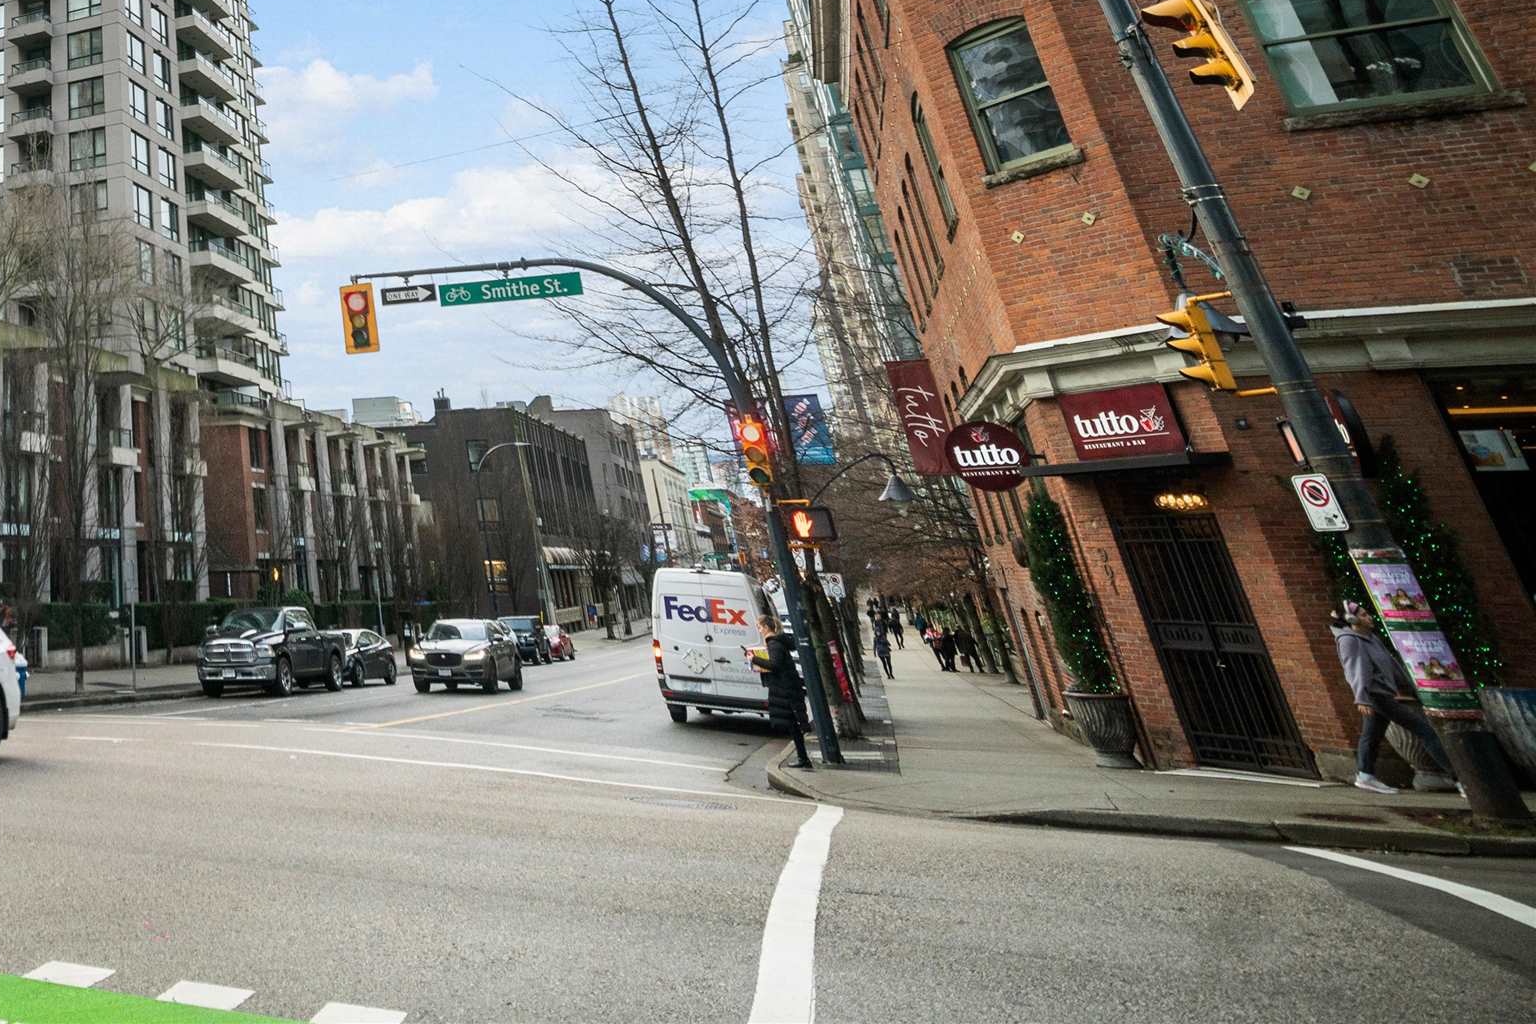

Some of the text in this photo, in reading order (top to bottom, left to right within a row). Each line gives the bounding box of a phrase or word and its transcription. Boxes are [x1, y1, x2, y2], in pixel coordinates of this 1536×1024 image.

[387, 290, 418, 300] ONE WAY
[480, 278, 568, 300] Smithe St.
[897, 385, 946, 447] tutto
[1073, 410, 1140, 438] tutto
[953, 443, 1020, 467] tutto
[1084, 440, 1124, 450] RESTAURANT
[664, 596, 748, 626] FedEx
